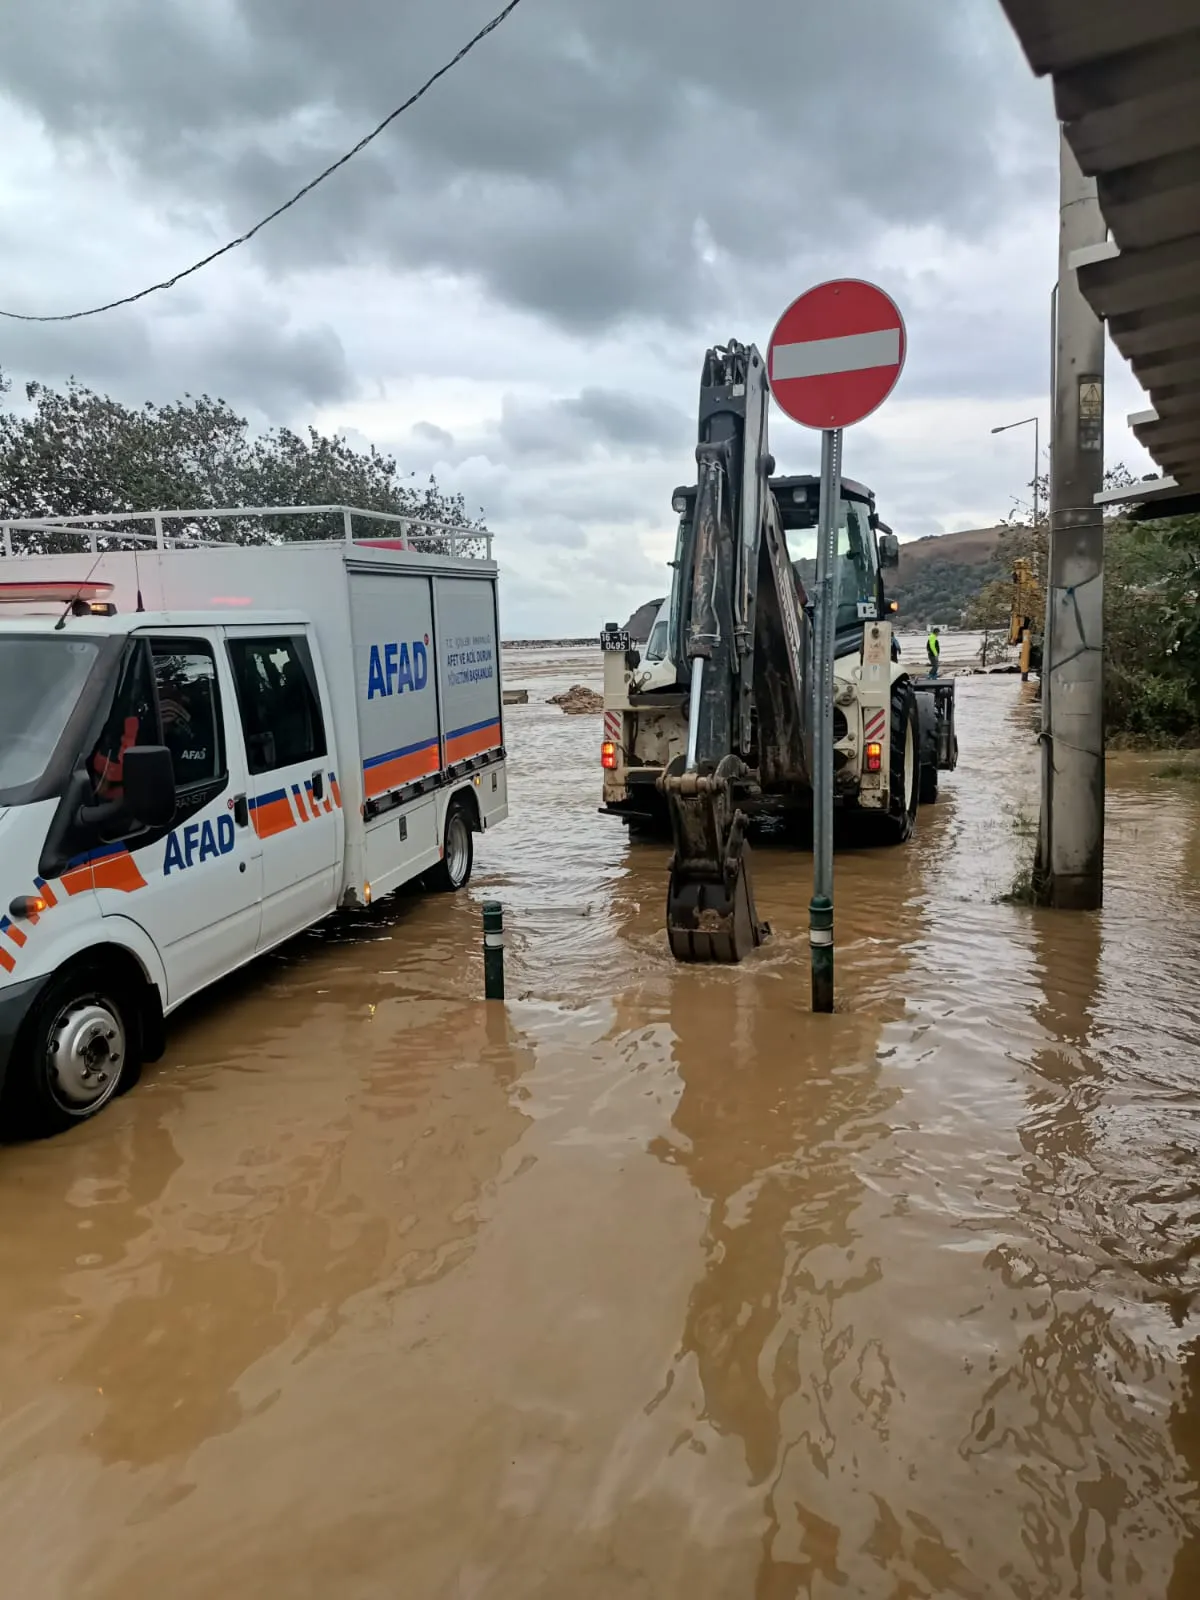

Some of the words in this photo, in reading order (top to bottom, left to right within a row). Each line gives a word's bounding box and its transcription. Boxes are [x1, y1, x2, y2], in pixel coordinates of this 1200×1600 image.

[367, 641, 428, 700] AFAD
[181, 750, 206, 760] AFAD
[163, 814, 235, 876] AFAD
